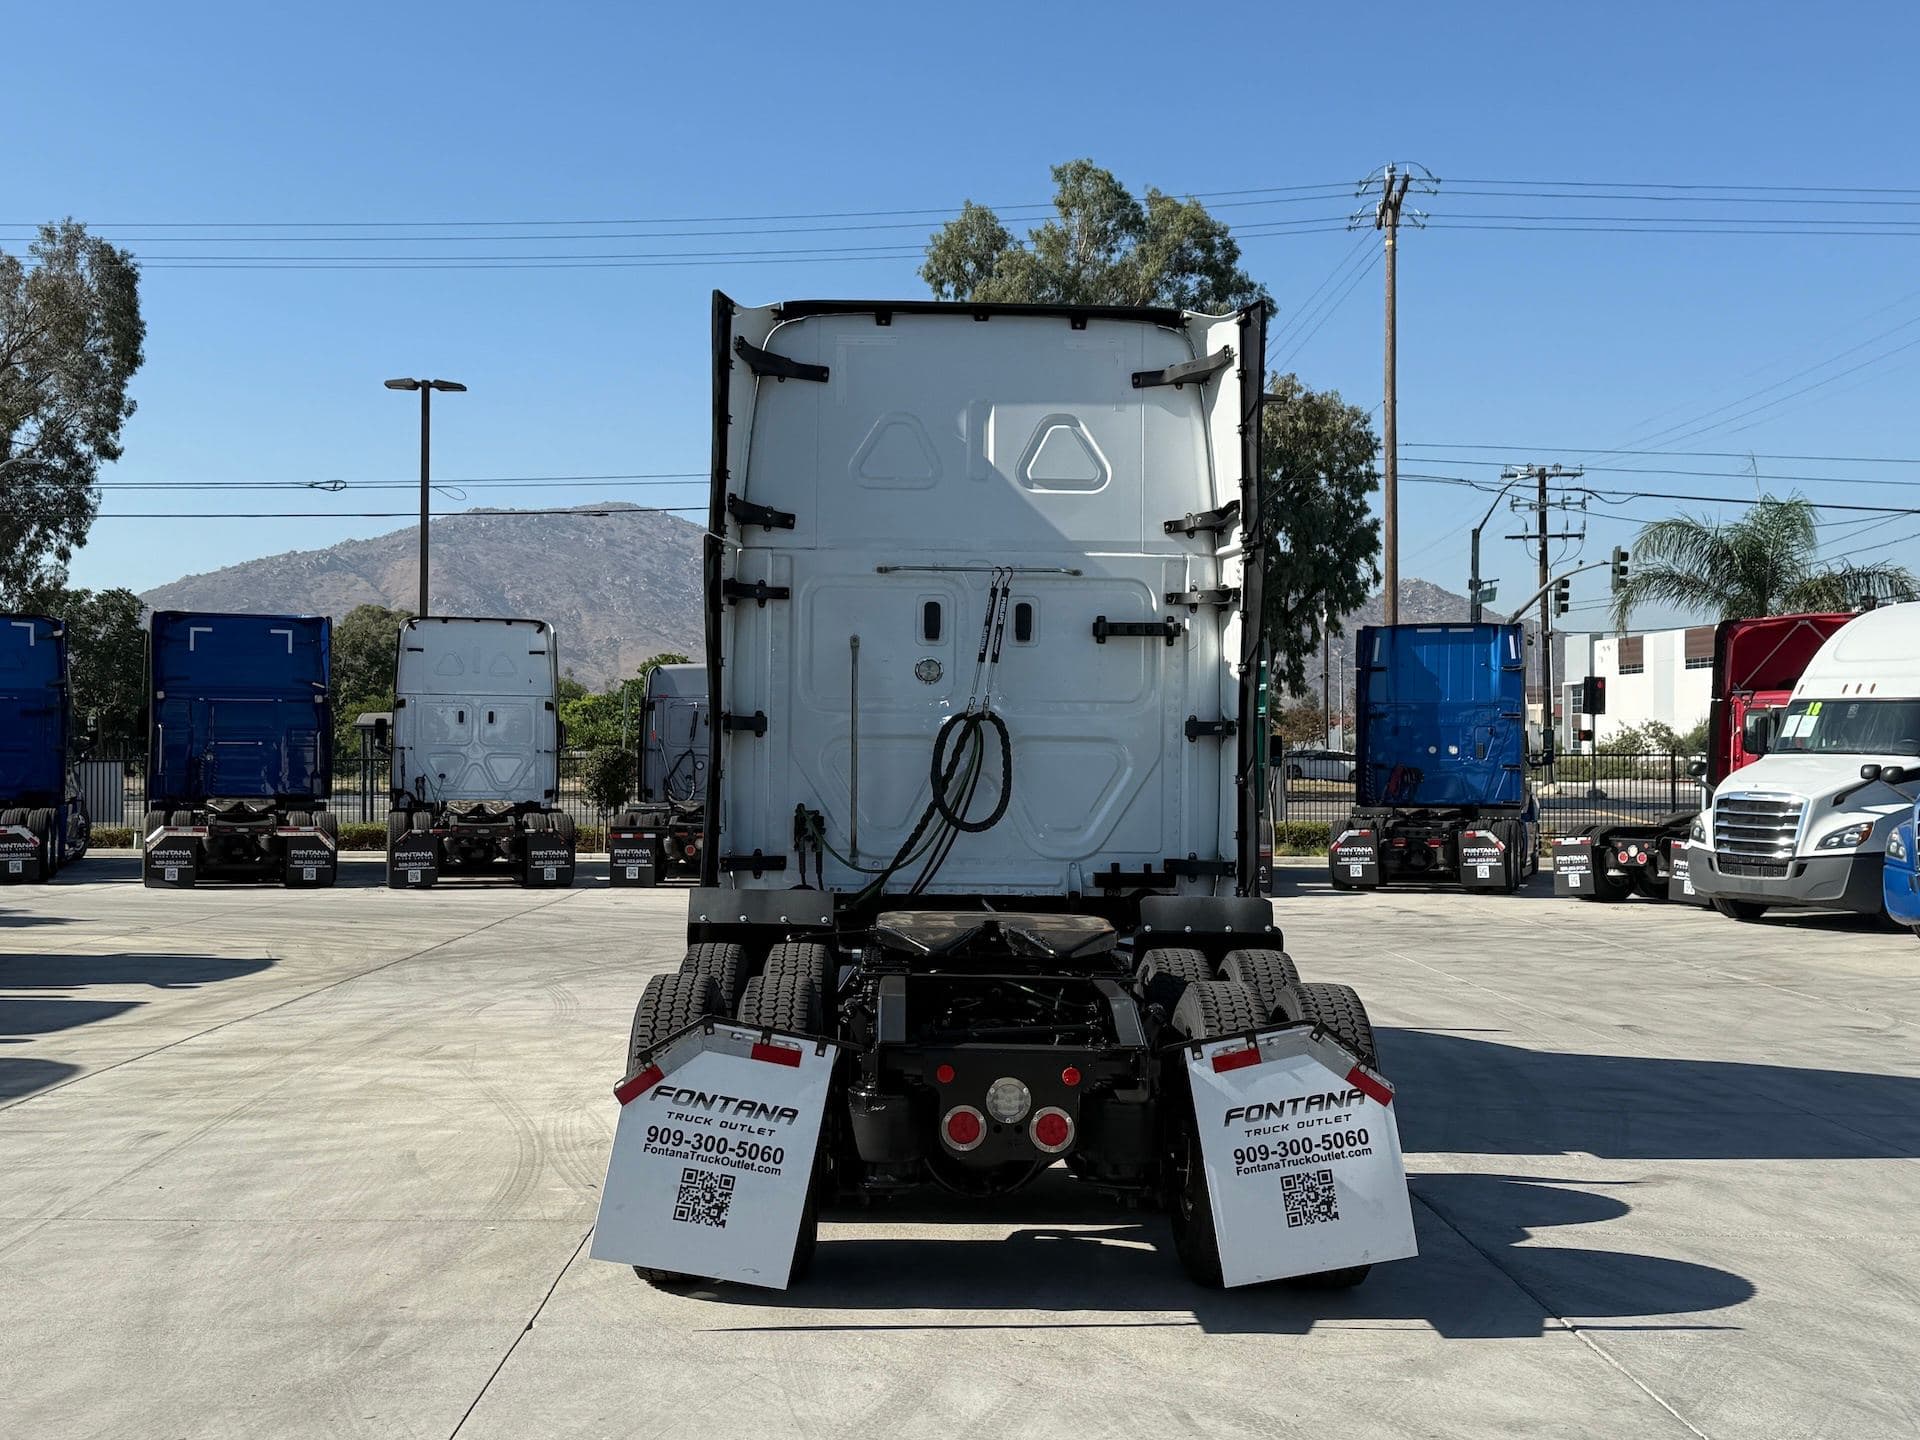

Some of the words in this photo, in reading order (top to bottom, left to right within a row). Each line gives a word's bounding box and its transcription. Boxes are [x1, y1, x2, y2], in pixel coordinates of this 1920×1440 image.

[649, 1085, 800, 1126] FONTANA
[1223, 1088, 1366, 1127] FONTANA
[666, 1111, 713, 1126] TRUCK
[719, 1120, 776, 1137] OUTLET
[1244, 1123, 1290, 1138] TRUCK
[1296, 1114, 1352, 1129] OUTLET
[643, 1143, 782, 1176] FontanaTruckOutlet.com
[646, 1125, 784, 1164] 909-300-5060
[1233, 1128, 1369, 1166] 909-300-5060
[1236, 1147, 1372, 1176] FontanaTruckOutlet.com
